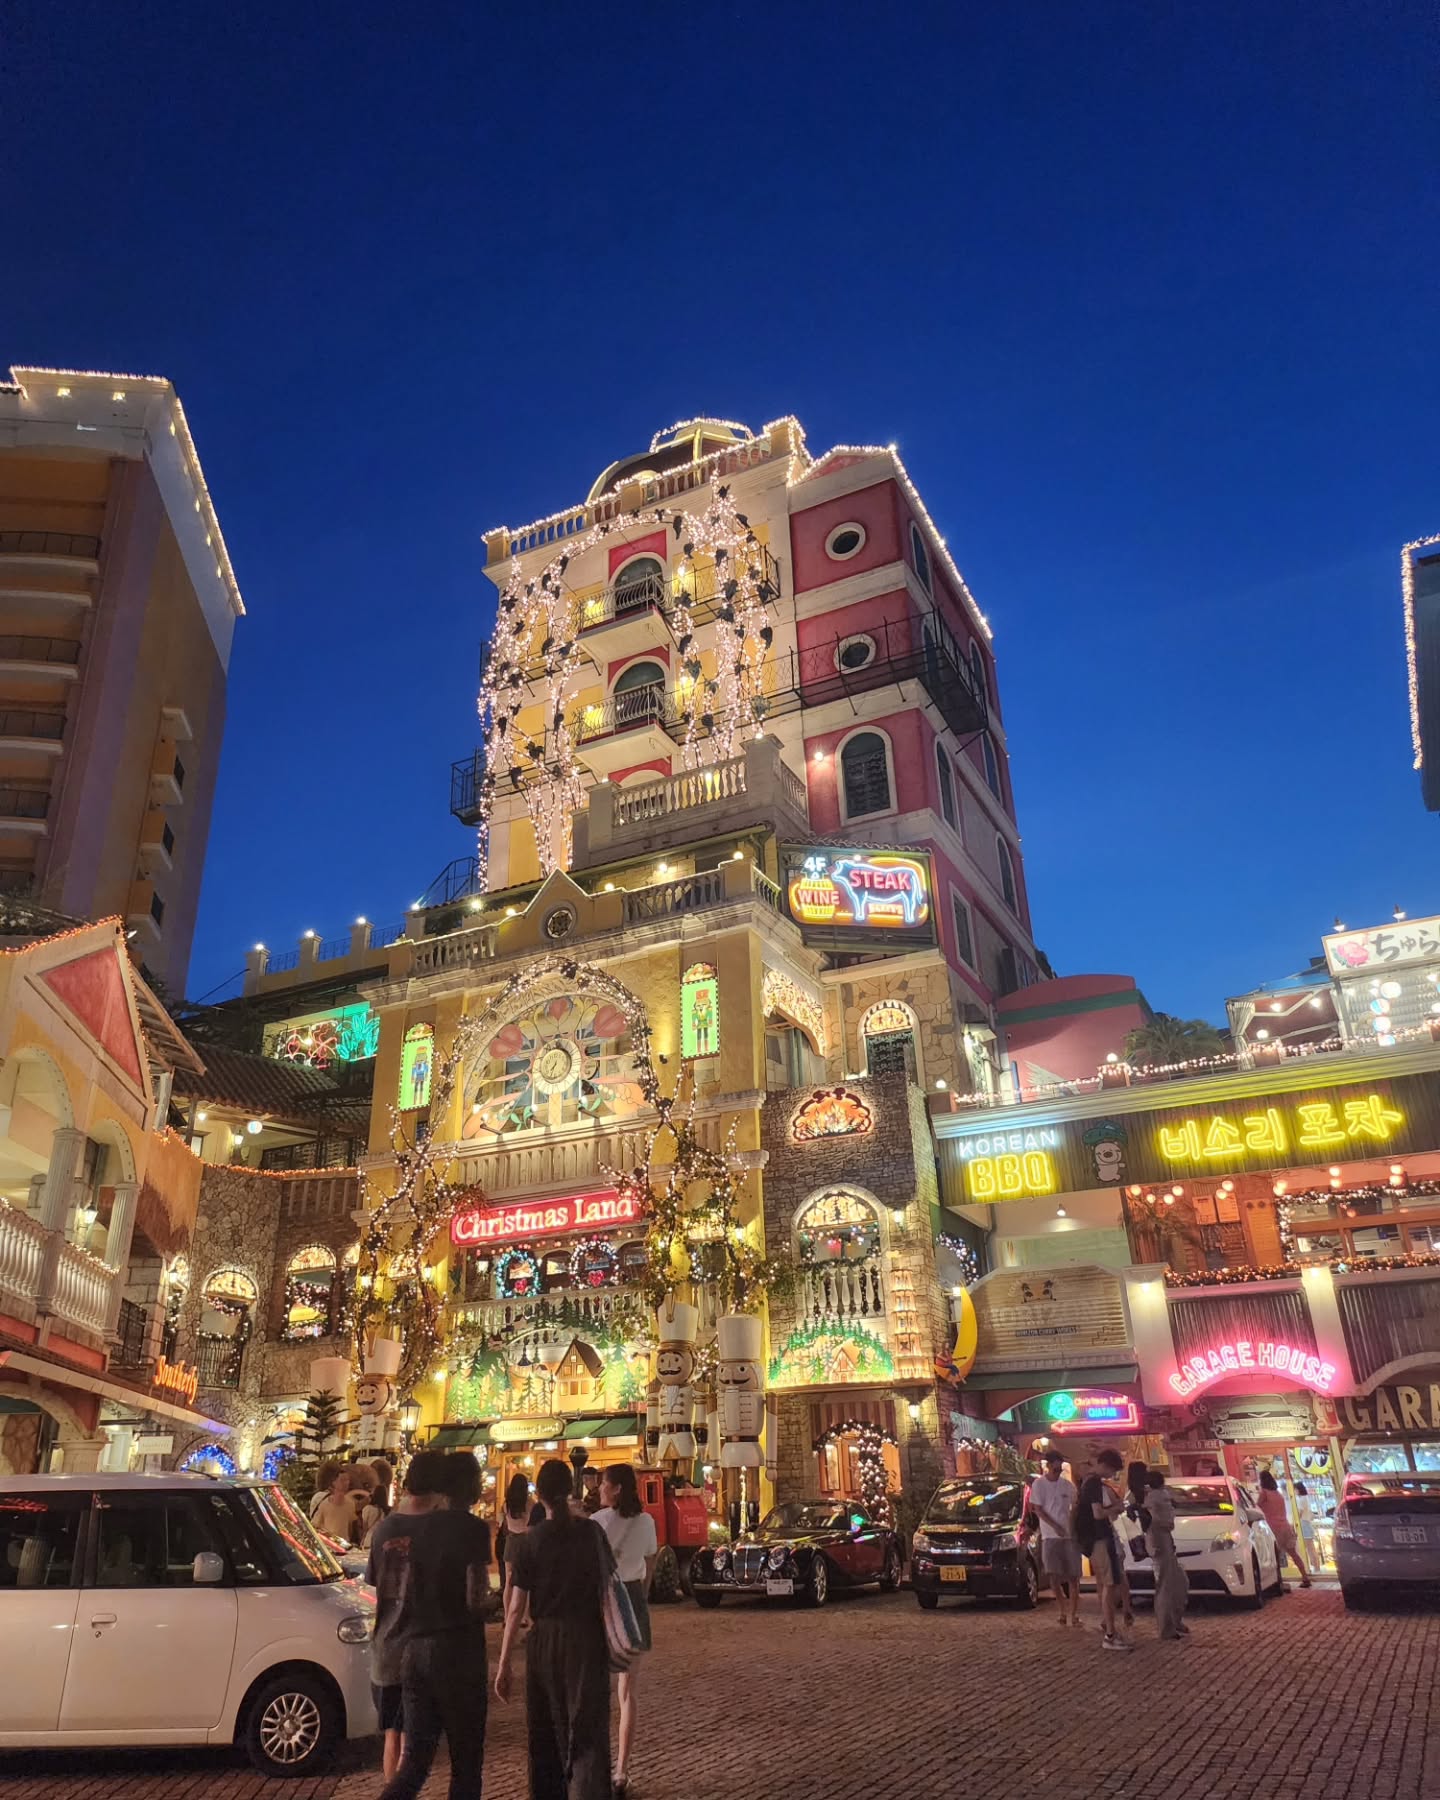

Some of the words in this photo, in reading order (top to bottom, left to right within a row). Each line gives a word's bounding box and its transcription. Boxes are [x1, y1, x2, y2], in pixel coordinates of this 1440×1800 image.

[804, 856, 826, 872] 4F
[849, 870, 912, 891] STEAK
[798, 889, 840, 905] WINE
[959, 1129, 1056, 1158] KOREAN
[1159, 1108, 1287, 1161] 비소리
[1297, 1094, 1404, 1145] 포차
[968, 1150, 1052, 1197] BBQ
[455, 1208, 569, 1240] Christmas
[574, 1197, 635, 1224] Land
[154, 1355, 199, 1406] Southerly
[1169, 1341, 1256, 1397] GARAGE
[1258, 1342, 1336, 1391] HOUSE
